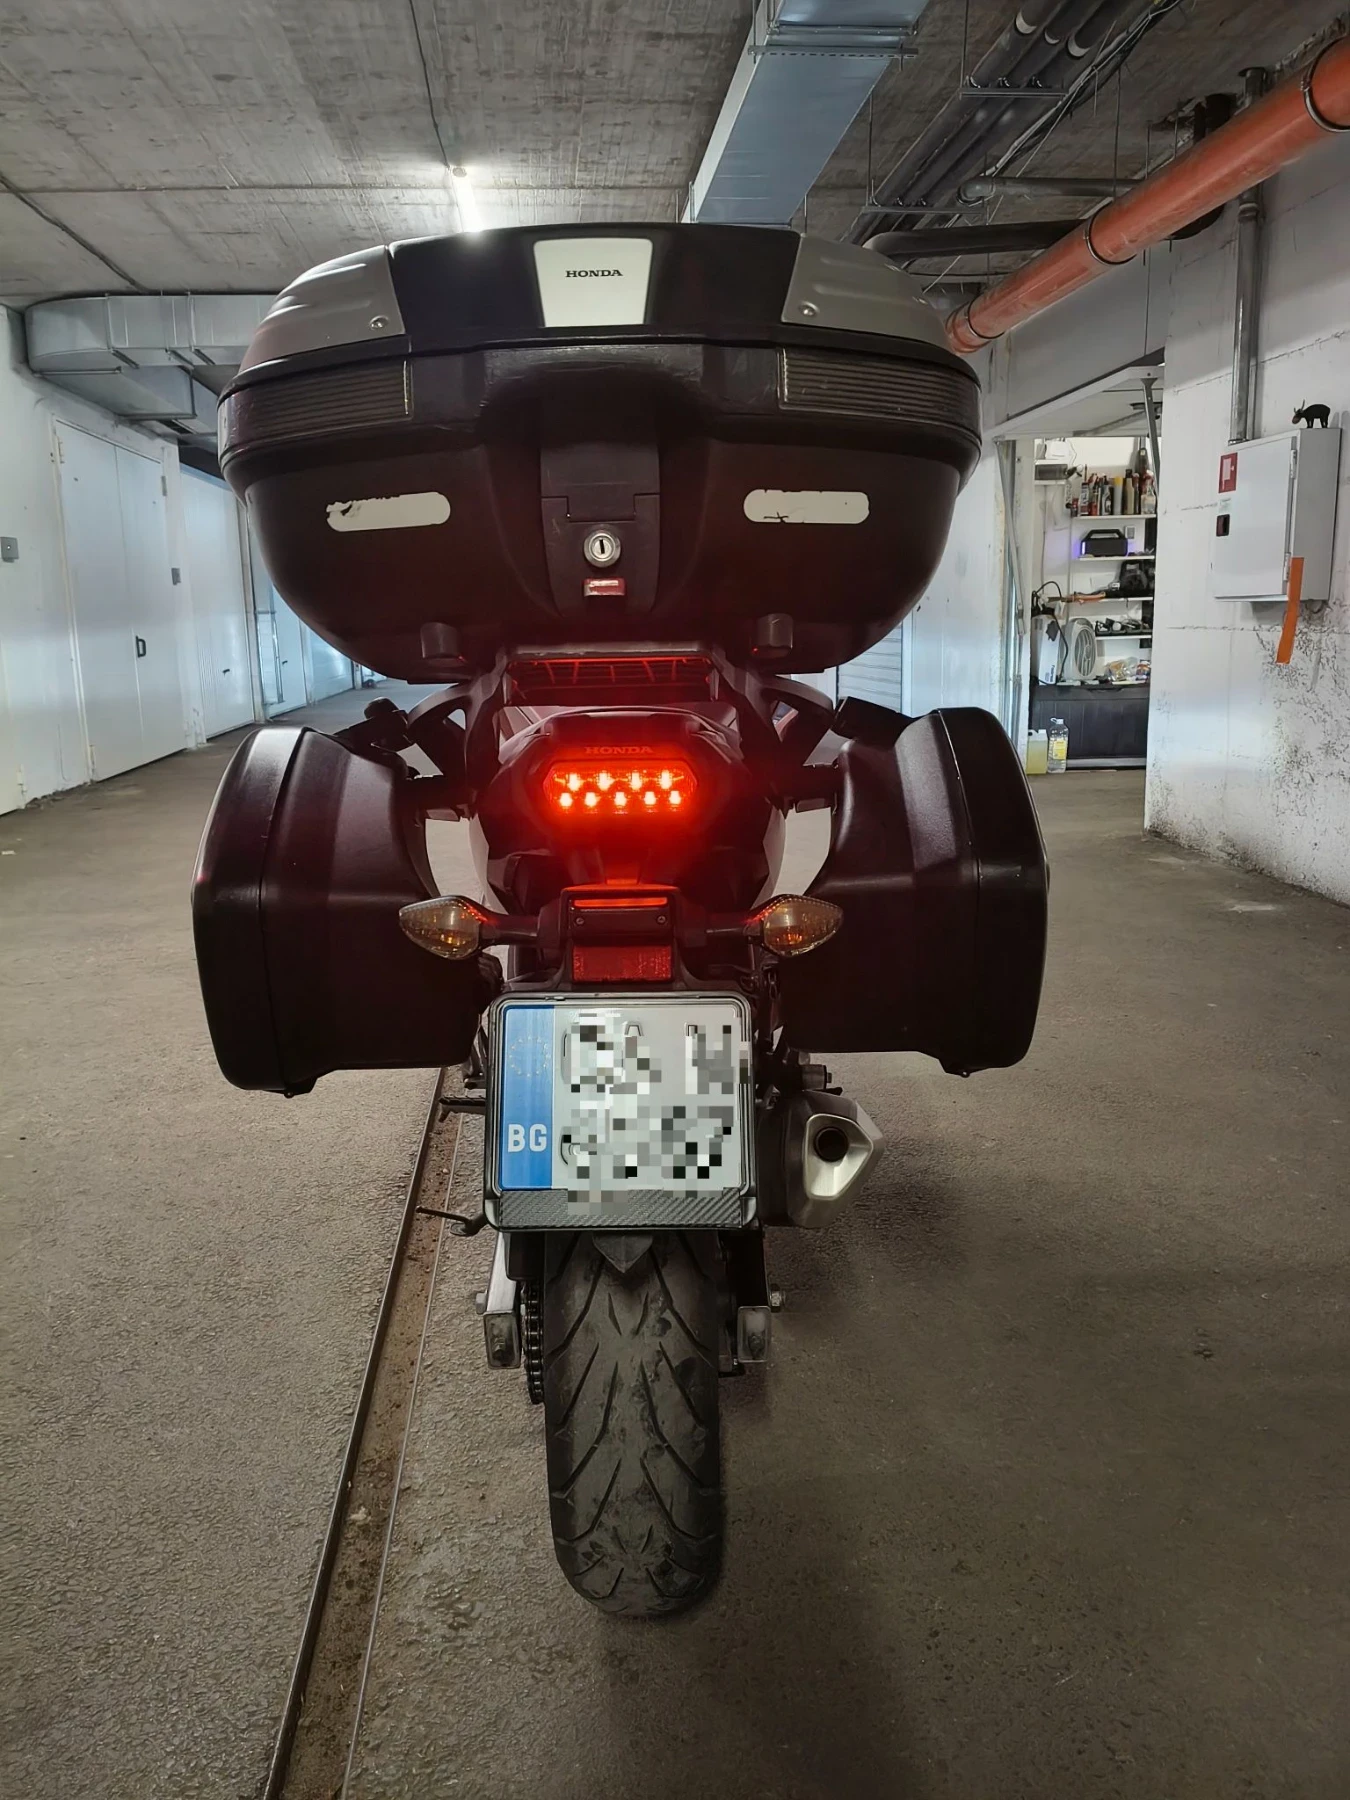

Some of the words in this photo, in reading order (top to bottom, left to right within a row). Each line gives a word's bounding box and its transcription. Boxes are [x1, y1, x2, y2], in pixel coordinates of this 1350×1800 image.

[565, 269, 623, 278] HONDA
[584, 746, 653, 754] HONDA
[507, 1123, 547, 1152] BG
